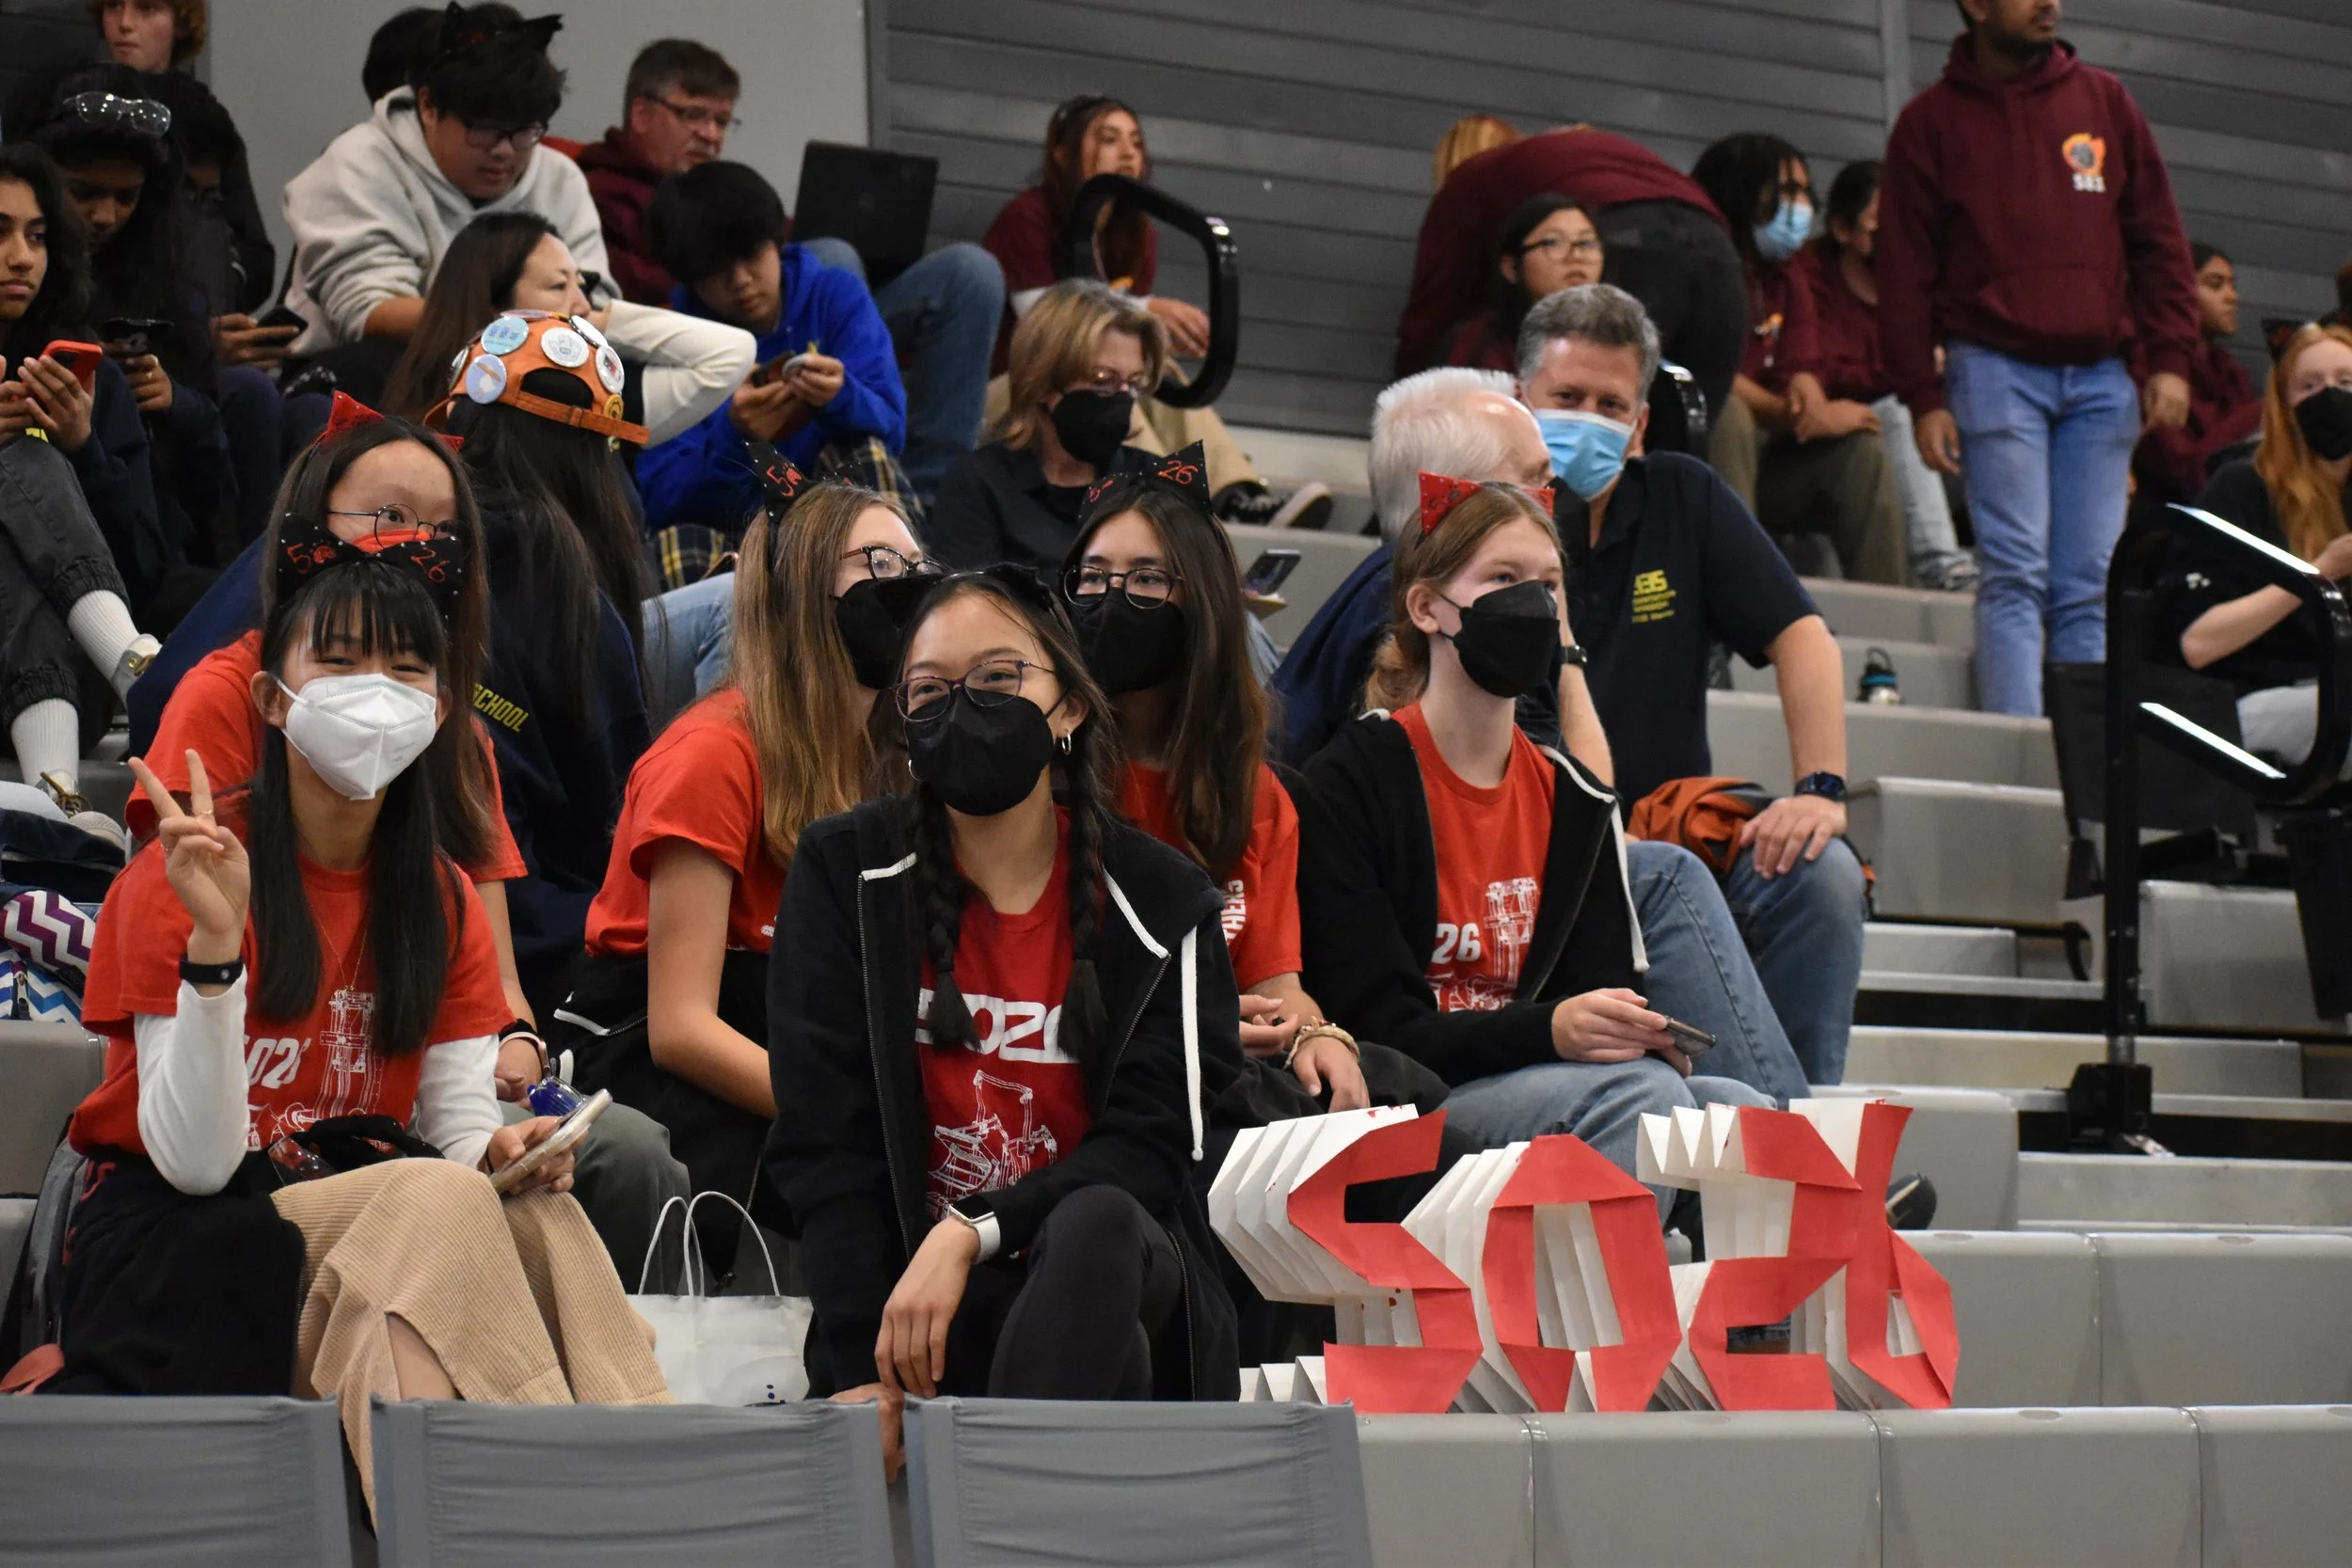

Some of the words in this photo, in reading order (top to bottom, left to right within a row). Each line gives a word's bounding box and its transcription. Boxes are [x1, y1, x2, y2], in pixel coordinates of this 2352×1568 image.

[1158, 459, 1199, 485] 26
[409, 546, 452, 584] 26
[1430, 923, 1482, 964] 26
